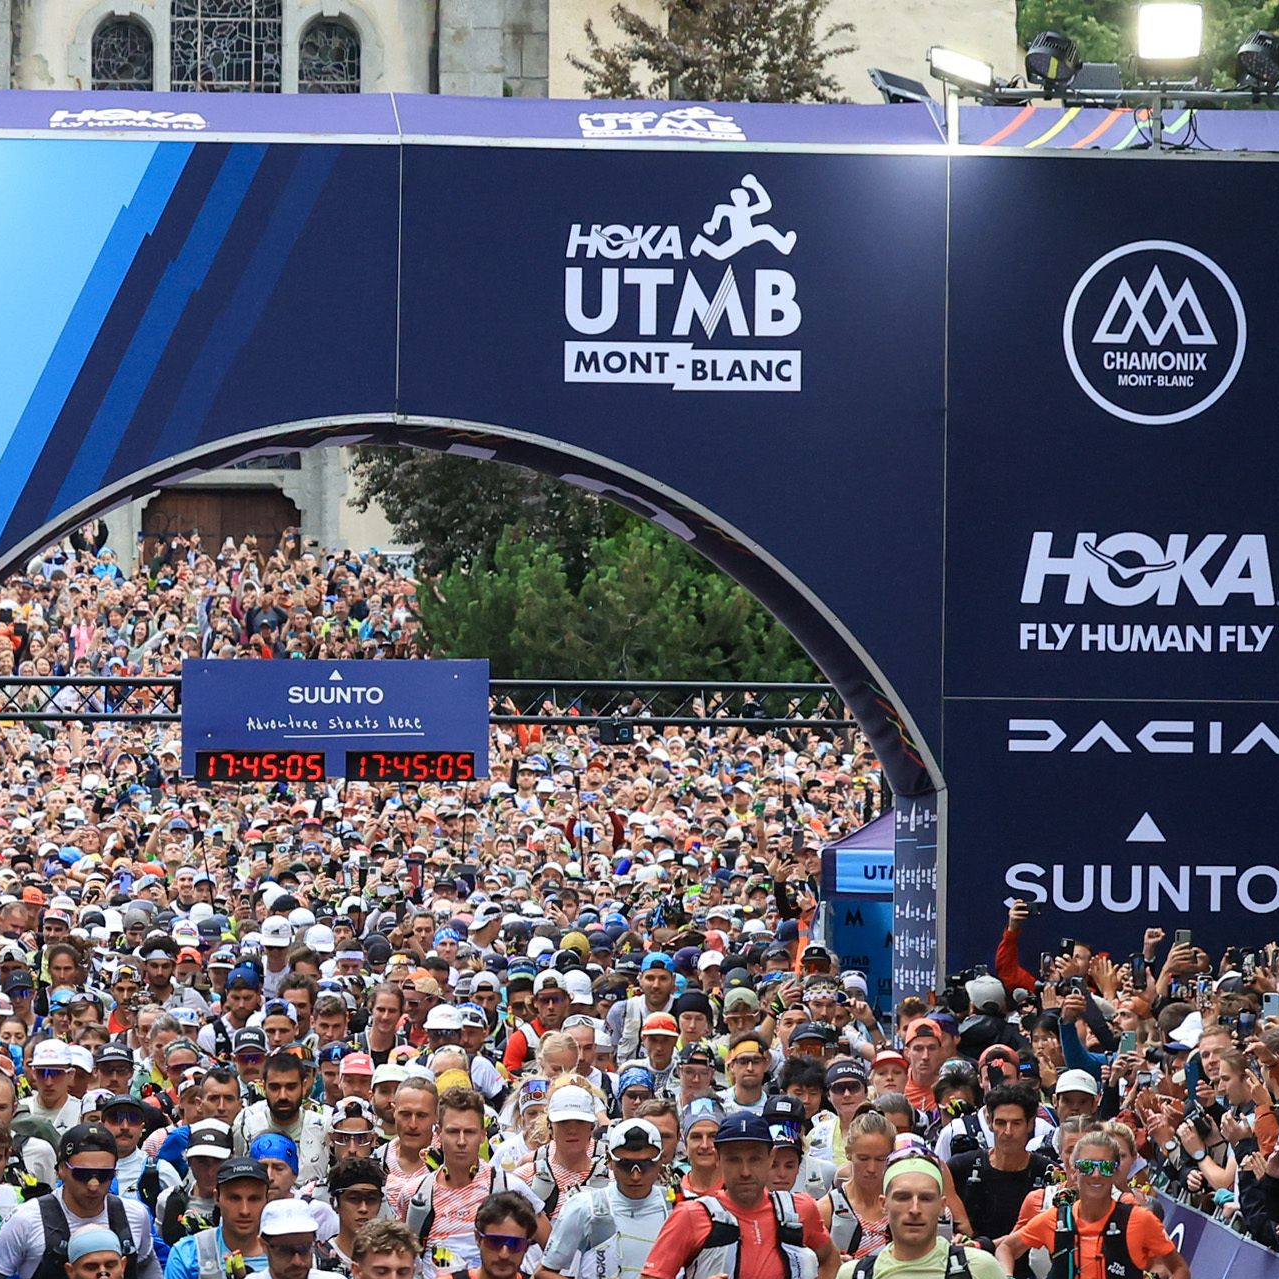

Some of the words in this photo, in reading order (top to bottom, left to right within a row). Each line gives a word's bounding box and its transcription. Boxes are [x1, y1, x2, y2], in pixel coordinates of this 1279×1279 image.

[49, 109, 207, 124] HOKA
[566, 224, 684, 260] HOKA
[565, 264, 802, 340] UTMB
[1103, 350, 1207, 372] CHAMONIX
[1117, 374, 1194, 388] MONT-BLANC
[1020, 531, 1276, 606] HOKA
[1019, 623, 1075, 651] FLY
[1081, 623, 1212, 652] HUMAN
[1219, 625, 1274, 653] FLY
[288, 686, 384, 704] SUUNTO
[207, 753, 322, 781] 17:45:05
[358, 753, 472, 781] 17:45:05
